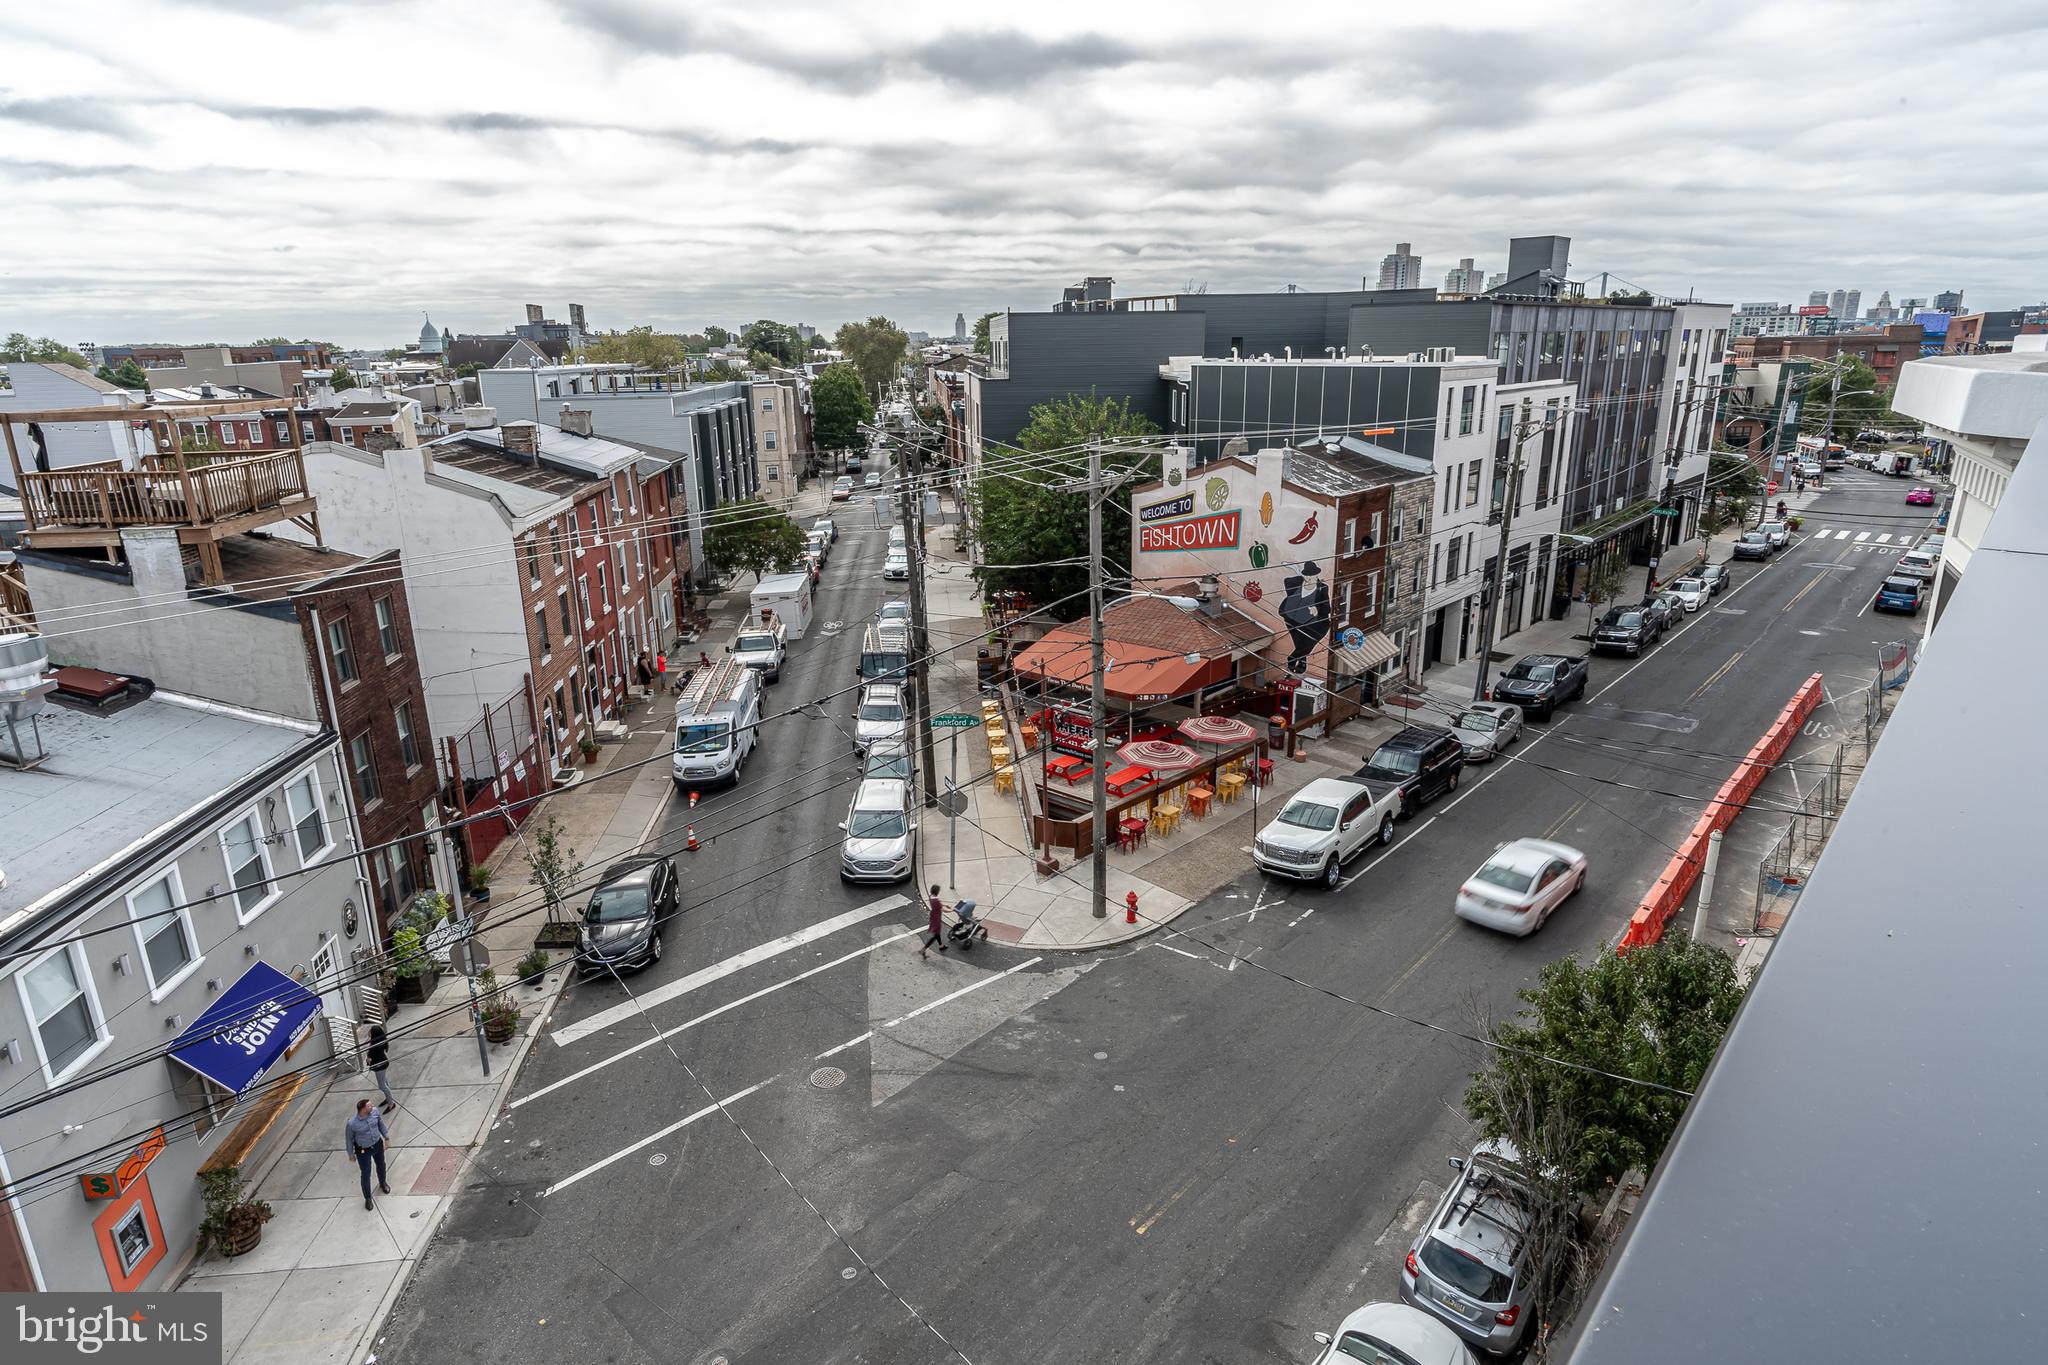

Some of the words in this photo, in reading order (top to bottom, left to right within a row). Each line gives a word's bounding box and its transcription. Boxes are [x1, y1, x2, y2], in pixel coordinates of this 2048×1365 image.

[1141, 502, 1177, 520] WELCOME
[1179, 498, 1192, 511] TO
[1141, 516, 1235, 548] FISHTOWN
[1854, 545, 1901, 556] STOP
[239, 1004, 288, 1056] JOINT
[90, 1176, 111, 1195] $
